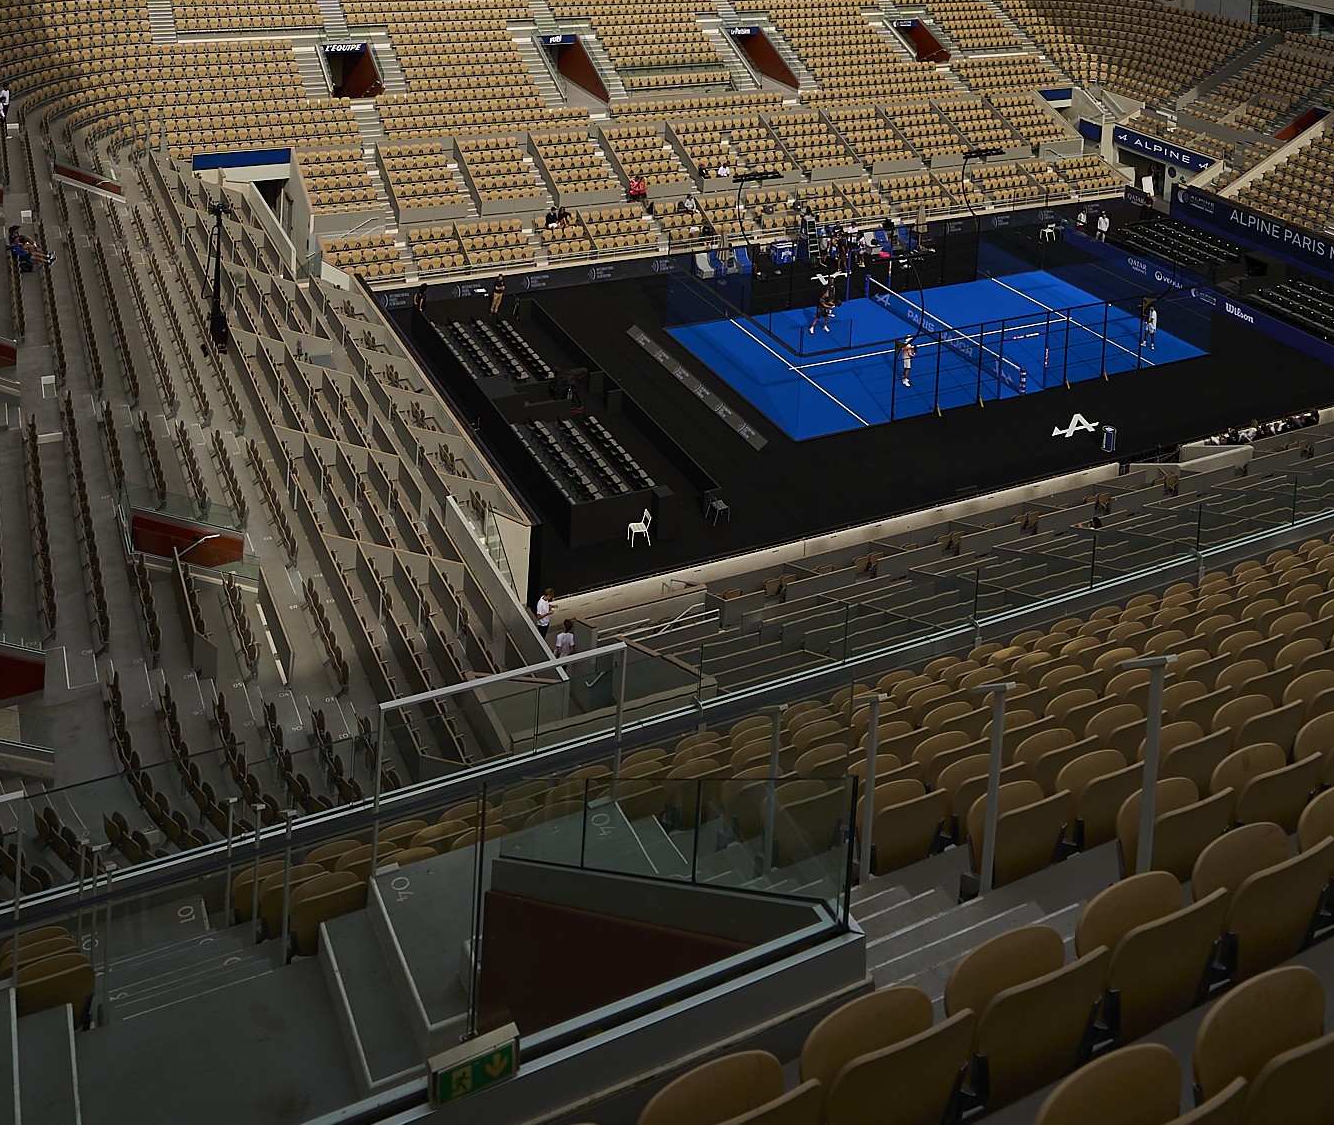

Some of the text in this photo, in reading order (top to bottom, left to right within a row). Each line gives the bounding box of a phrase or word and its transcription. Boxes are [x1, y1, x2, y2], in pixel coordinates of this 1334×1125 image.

[1134, 138, 1192, 165] ALPINE
[1229, 209, 1281, 239] ALPINE
[1283, 228, 1325, 256] PARIS
[1127, 257, 1147, 270] QATAR
[1224, 302, 1255, 325] Wilson
